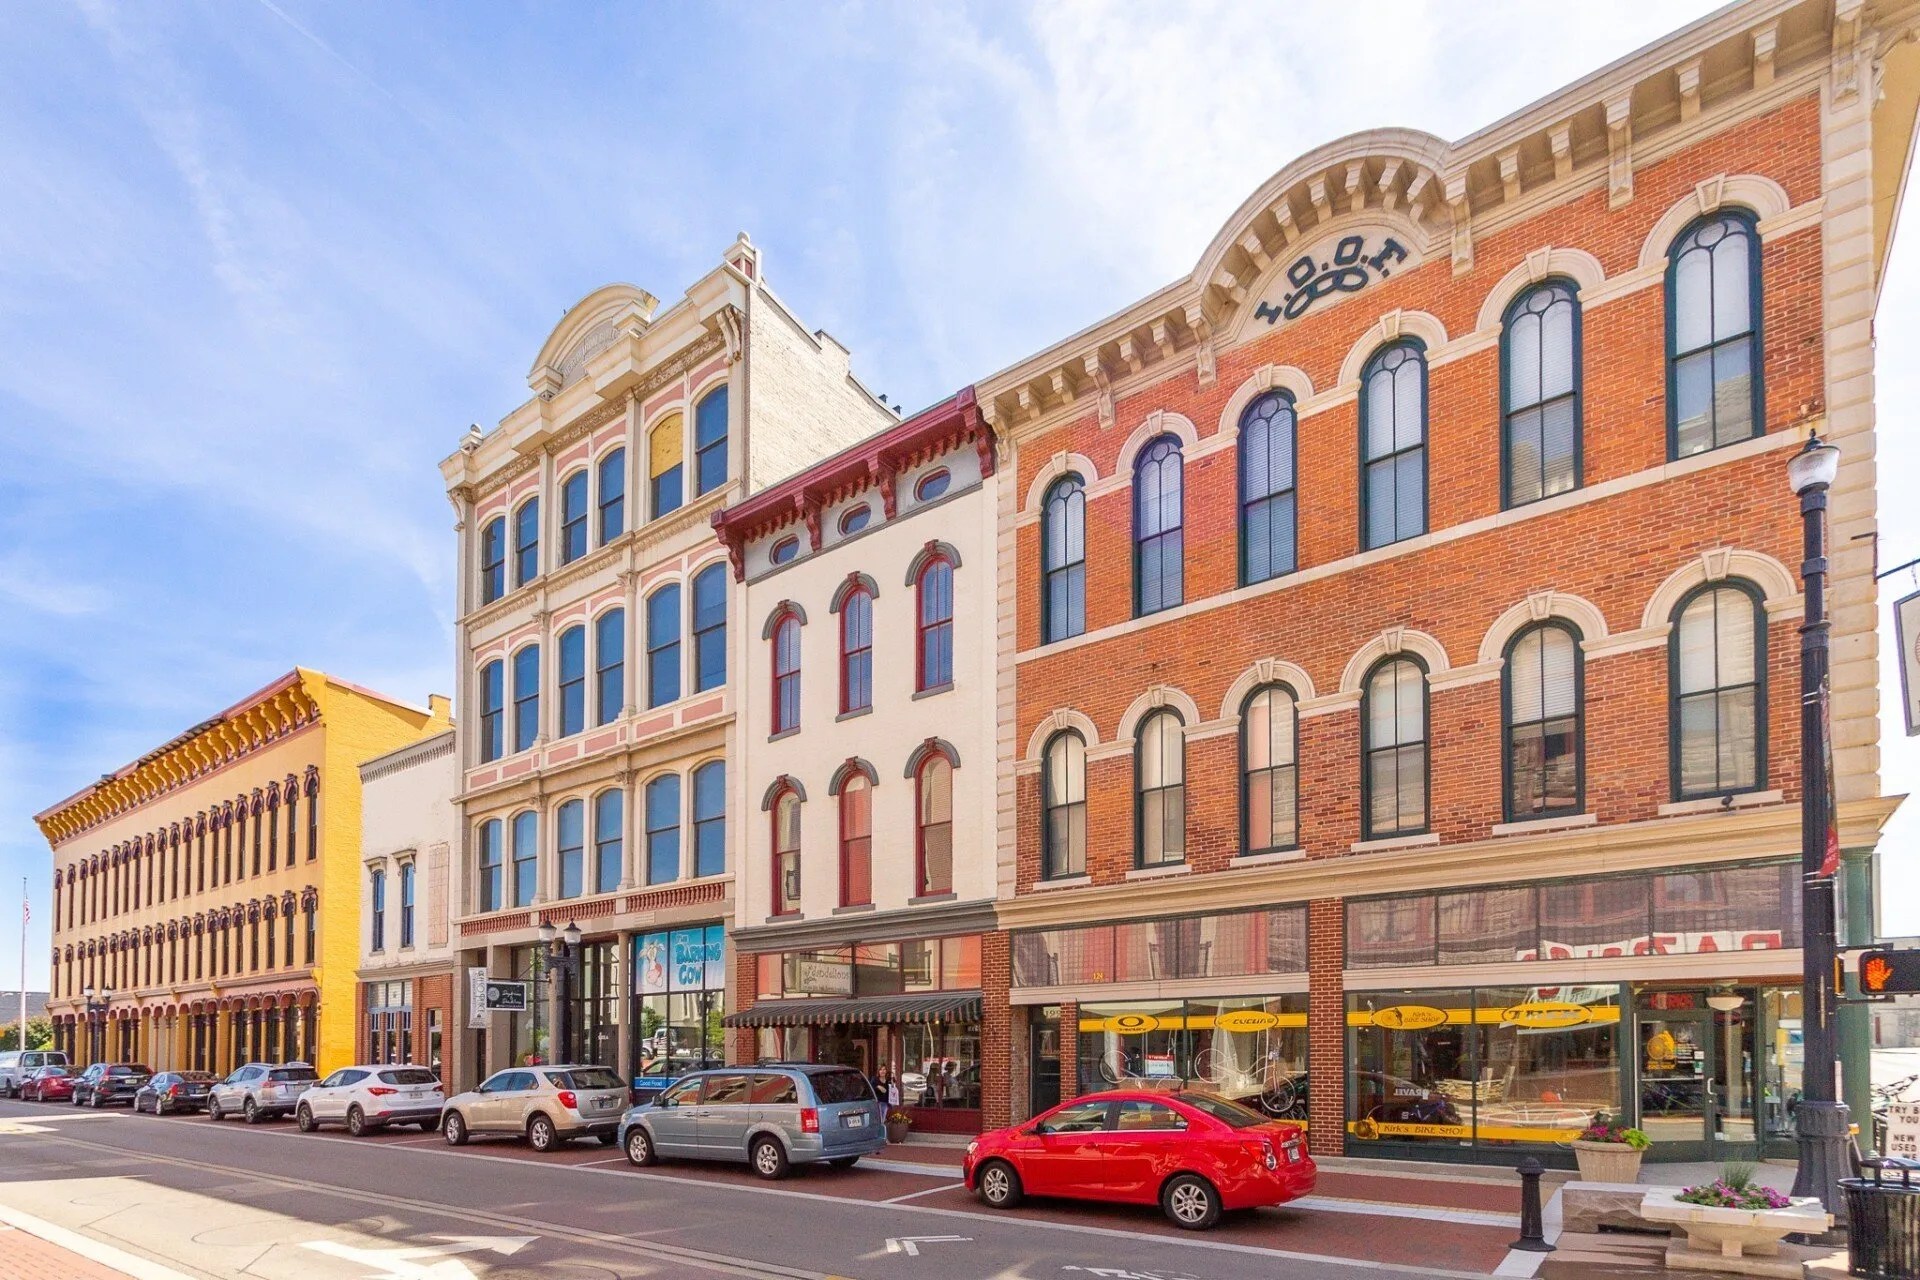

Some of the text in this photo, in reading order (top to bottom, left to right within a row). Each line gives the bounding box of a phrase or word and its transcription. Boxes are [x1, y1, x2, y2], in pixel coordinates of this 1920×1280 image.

[675, 942, 722, 965] BARKING
[678, 964, 702, 985] COW
[1889, 1106, 1907, 1114] TRY
[1900, 1116, 1919, 1124] YOU
[1383, 1124, 1409, 1133] Kirk's
[1414, 1125, 1437, 1134] BIKE
[1893, 1134, 1916, 1142] NEW
[1891, 1143, 1918, 1152] USED
